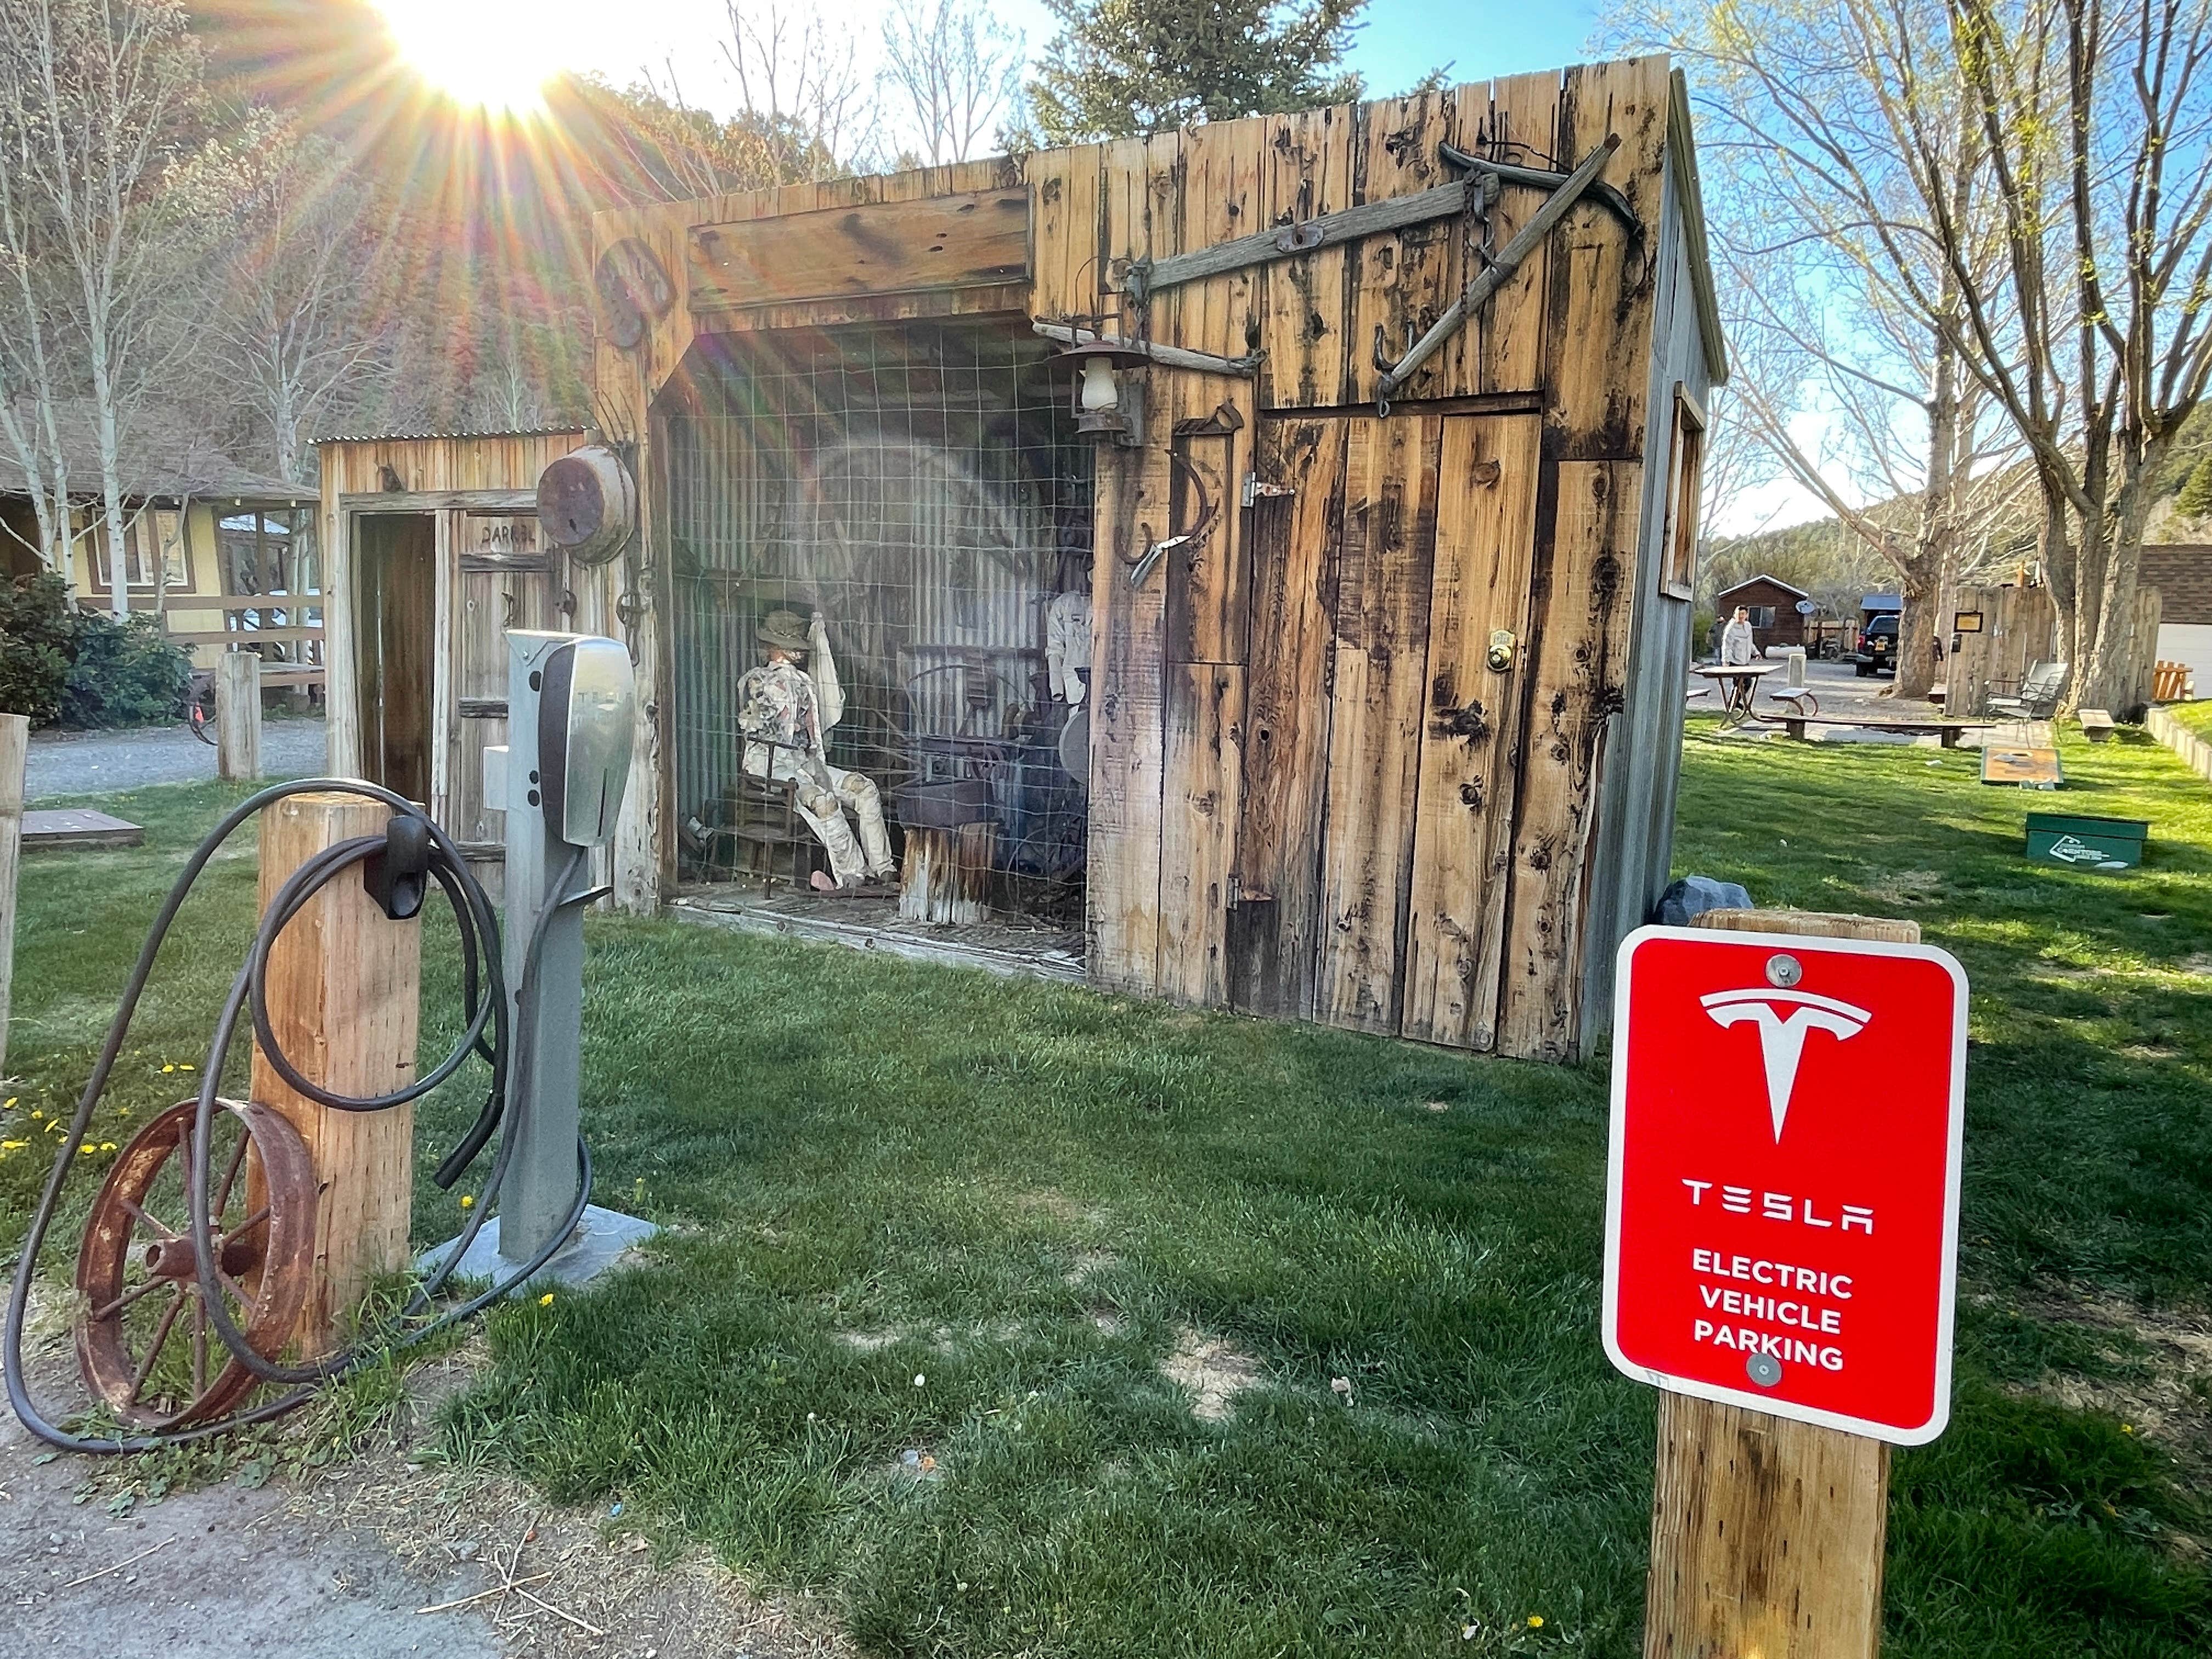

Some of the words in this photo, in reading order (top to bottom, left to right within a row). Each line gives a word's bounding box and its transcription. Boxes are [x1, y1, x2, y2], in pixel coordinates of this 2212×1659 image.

[1683, 1179, 1873, 1234] TESLA
[1694, 1249, 1852, 1299] ELECTRIC
[1700, 1285, 1841, 1334] VEHICLE
[1695, 1319, 1843, 1370] PARKING
